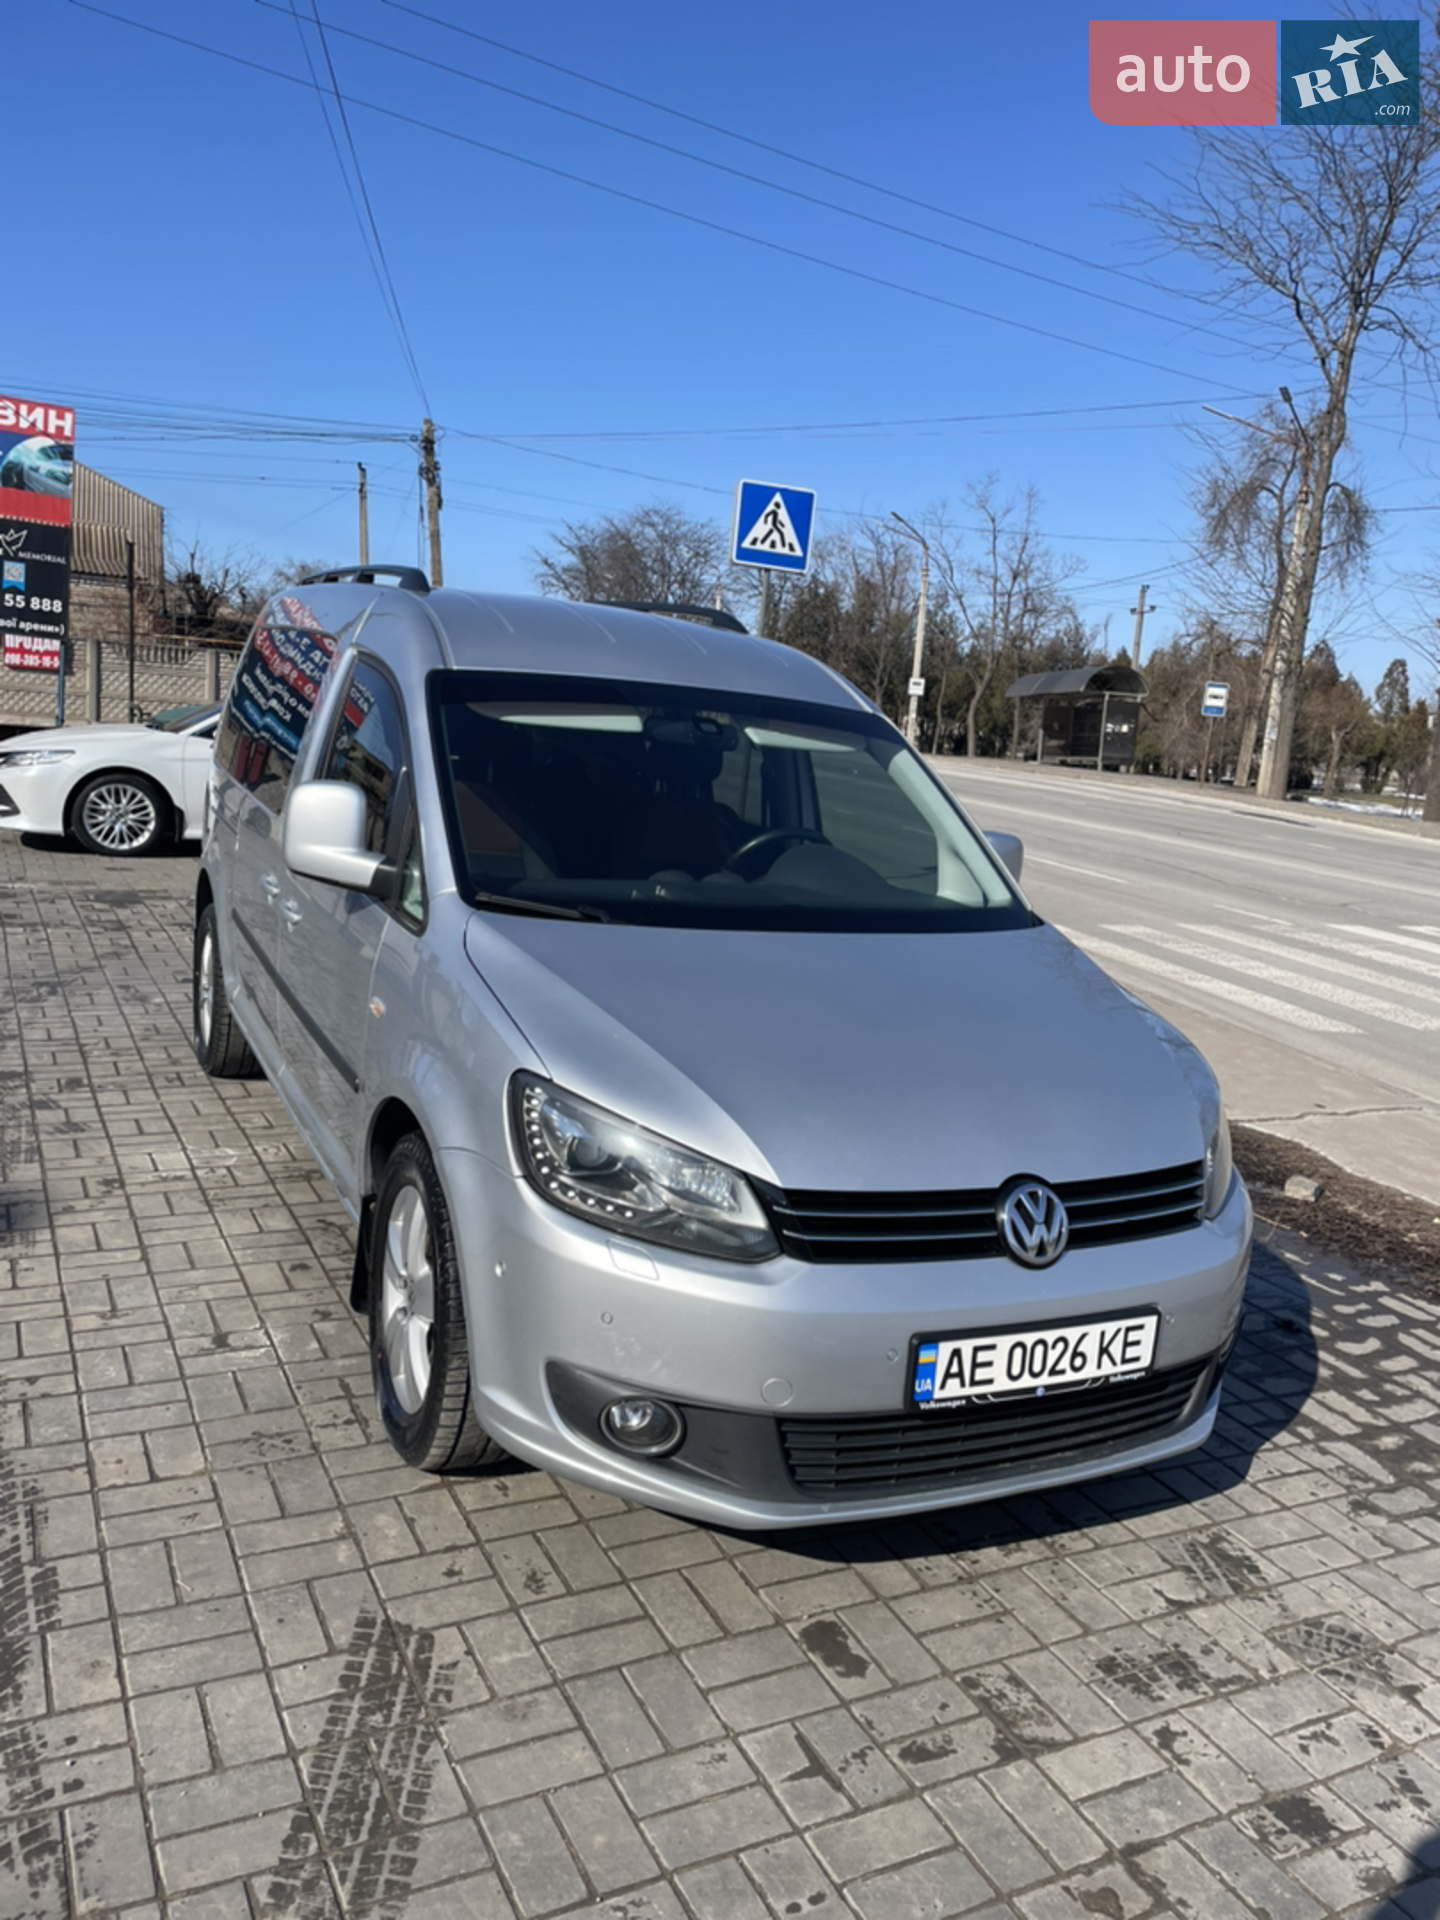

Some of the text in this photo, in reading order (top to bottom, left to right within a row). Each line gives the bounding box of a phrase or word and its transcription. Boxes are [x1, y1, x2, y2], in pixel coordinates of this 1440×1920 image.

[4, 593, 62, 613] 55 888
[939, 1323, 1146, 1390] AE 0026 KE
[915, 1378, 932, 1393] UA
